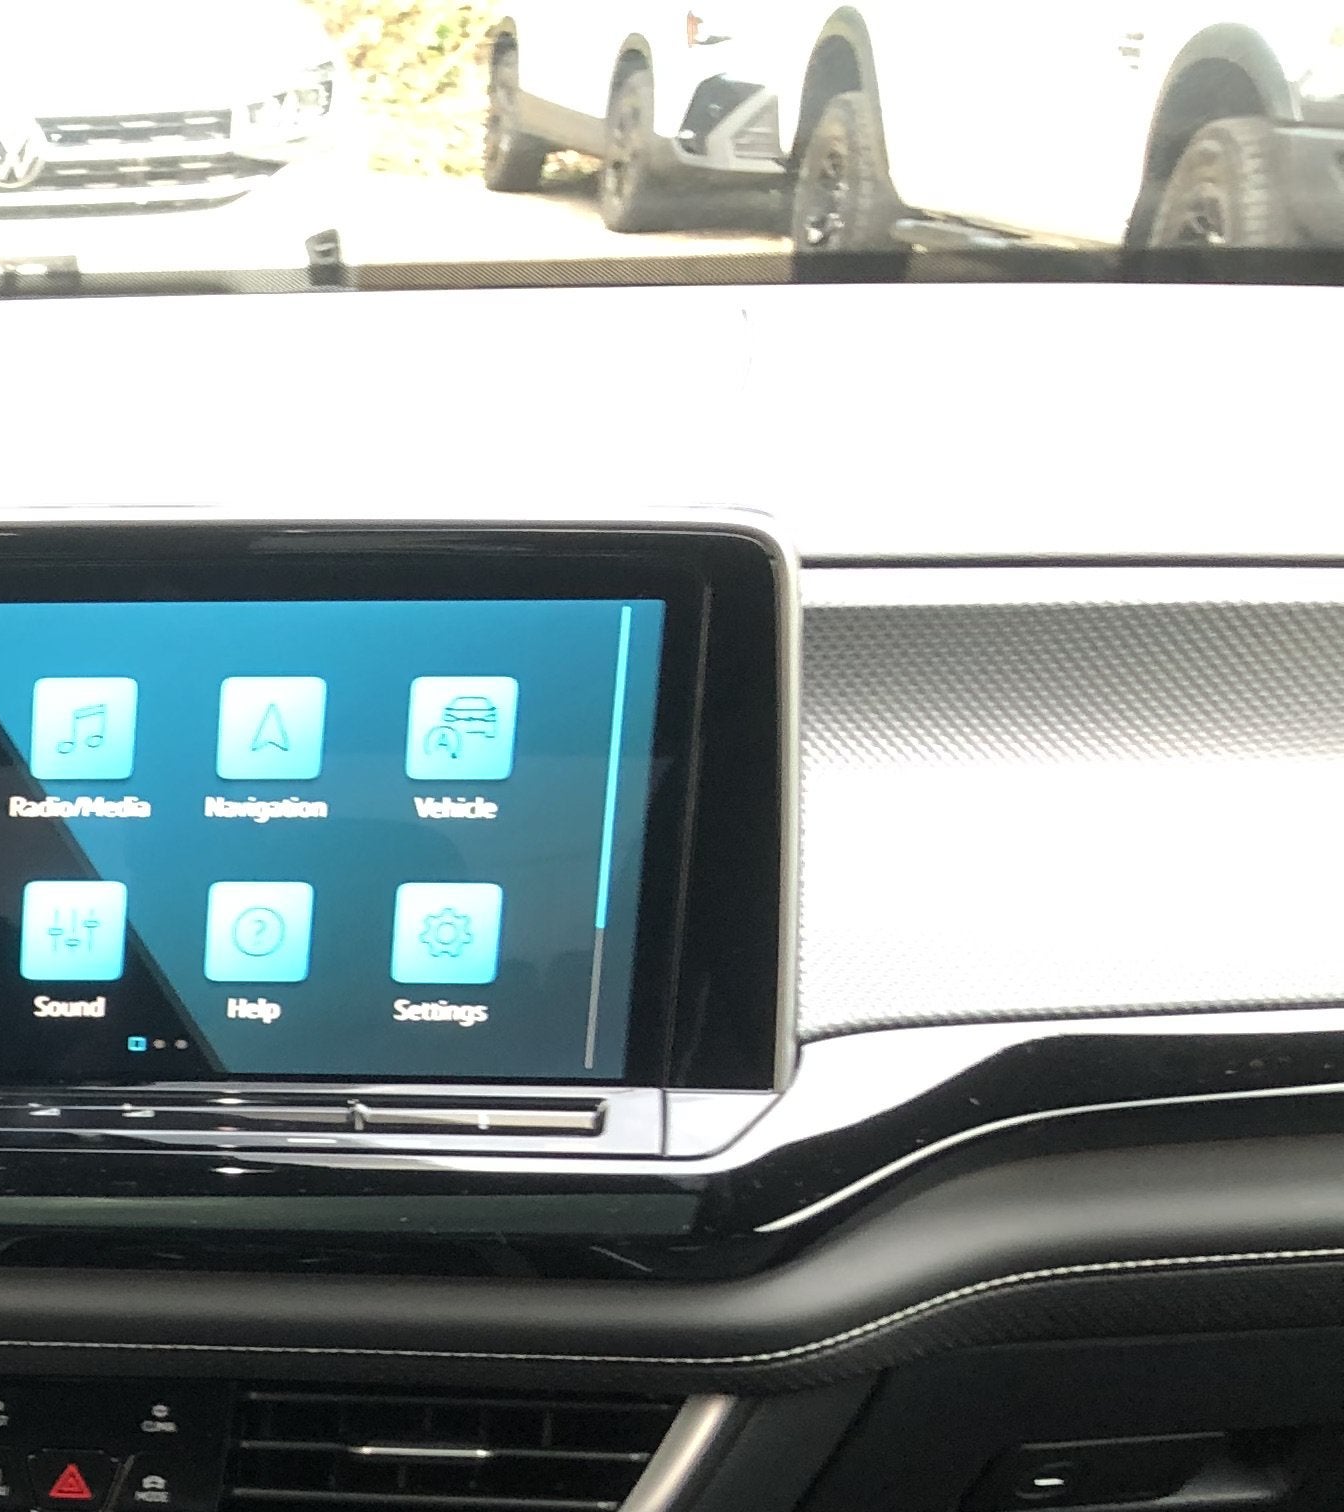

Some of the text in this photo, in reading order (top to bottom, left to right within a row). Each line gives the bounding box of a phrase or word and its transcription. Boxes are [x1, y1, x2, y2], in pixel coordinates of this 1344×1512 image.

[9, 795, 152, 819] Radio/Media
[204, 796, 328, 823] Navigation
[413, 797, 499, 819] Vehicle
[33, 995, 107, 1018] Sound
[226, 998, 282, 1023] Help
[392, 998, 489, 1027] Settings
